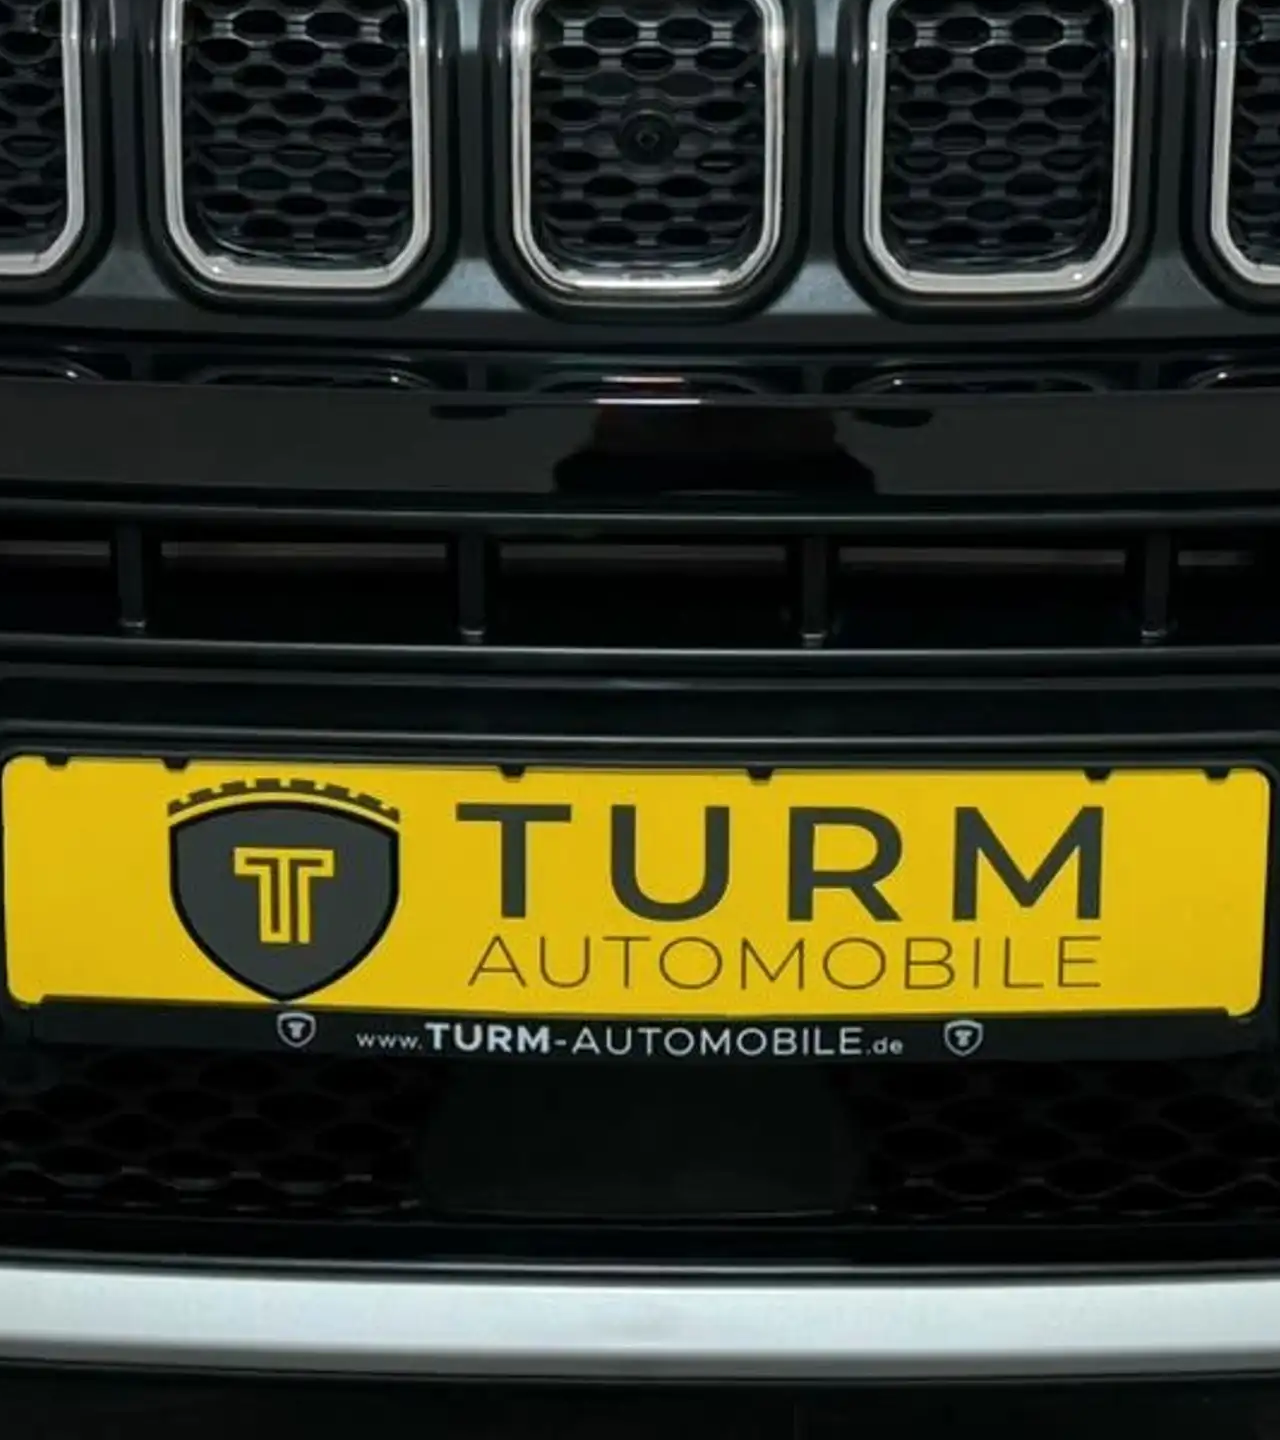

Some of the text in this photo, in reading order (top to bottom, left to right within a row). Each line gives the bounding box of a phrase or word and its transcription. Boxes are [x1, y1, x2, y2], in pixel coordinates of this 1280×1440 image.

[456, 803, 1105, 921] TURM
[468, 934, 1102, 991] AUTOMOBILE
[356, 1022, 903, 1057] www.TURM-AUTOMOBILE.de
